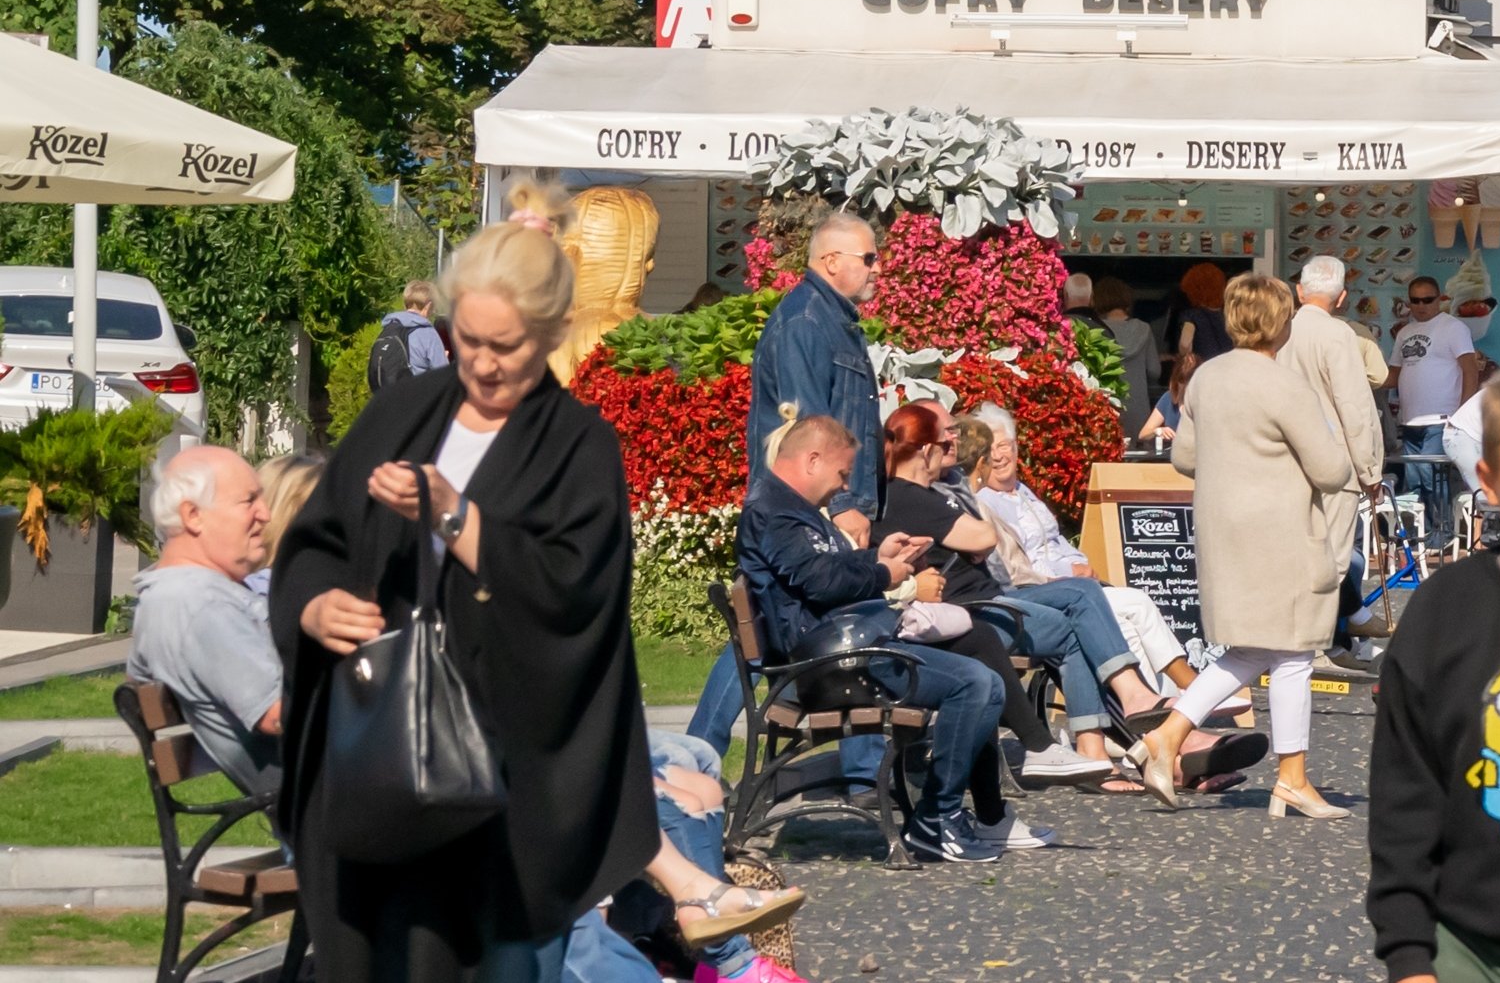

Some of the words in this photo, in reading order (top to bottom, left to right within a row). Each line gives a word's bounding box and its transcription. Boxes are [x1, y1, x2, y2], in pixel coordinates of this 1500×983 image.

[26, 124, 109, 167] Kozel
[177, 142, 259, 186] Kozel
[596, 128, 682, 159] GOFRY
[728, 131, 787, 161] LOD
[1082, 141, 1137, 168] 1987
[1186, 140, 1287, 170] DESERY
[1337, 142, 1408, 171] KAWA
[1131, 518, 1181, 537] Kozel
